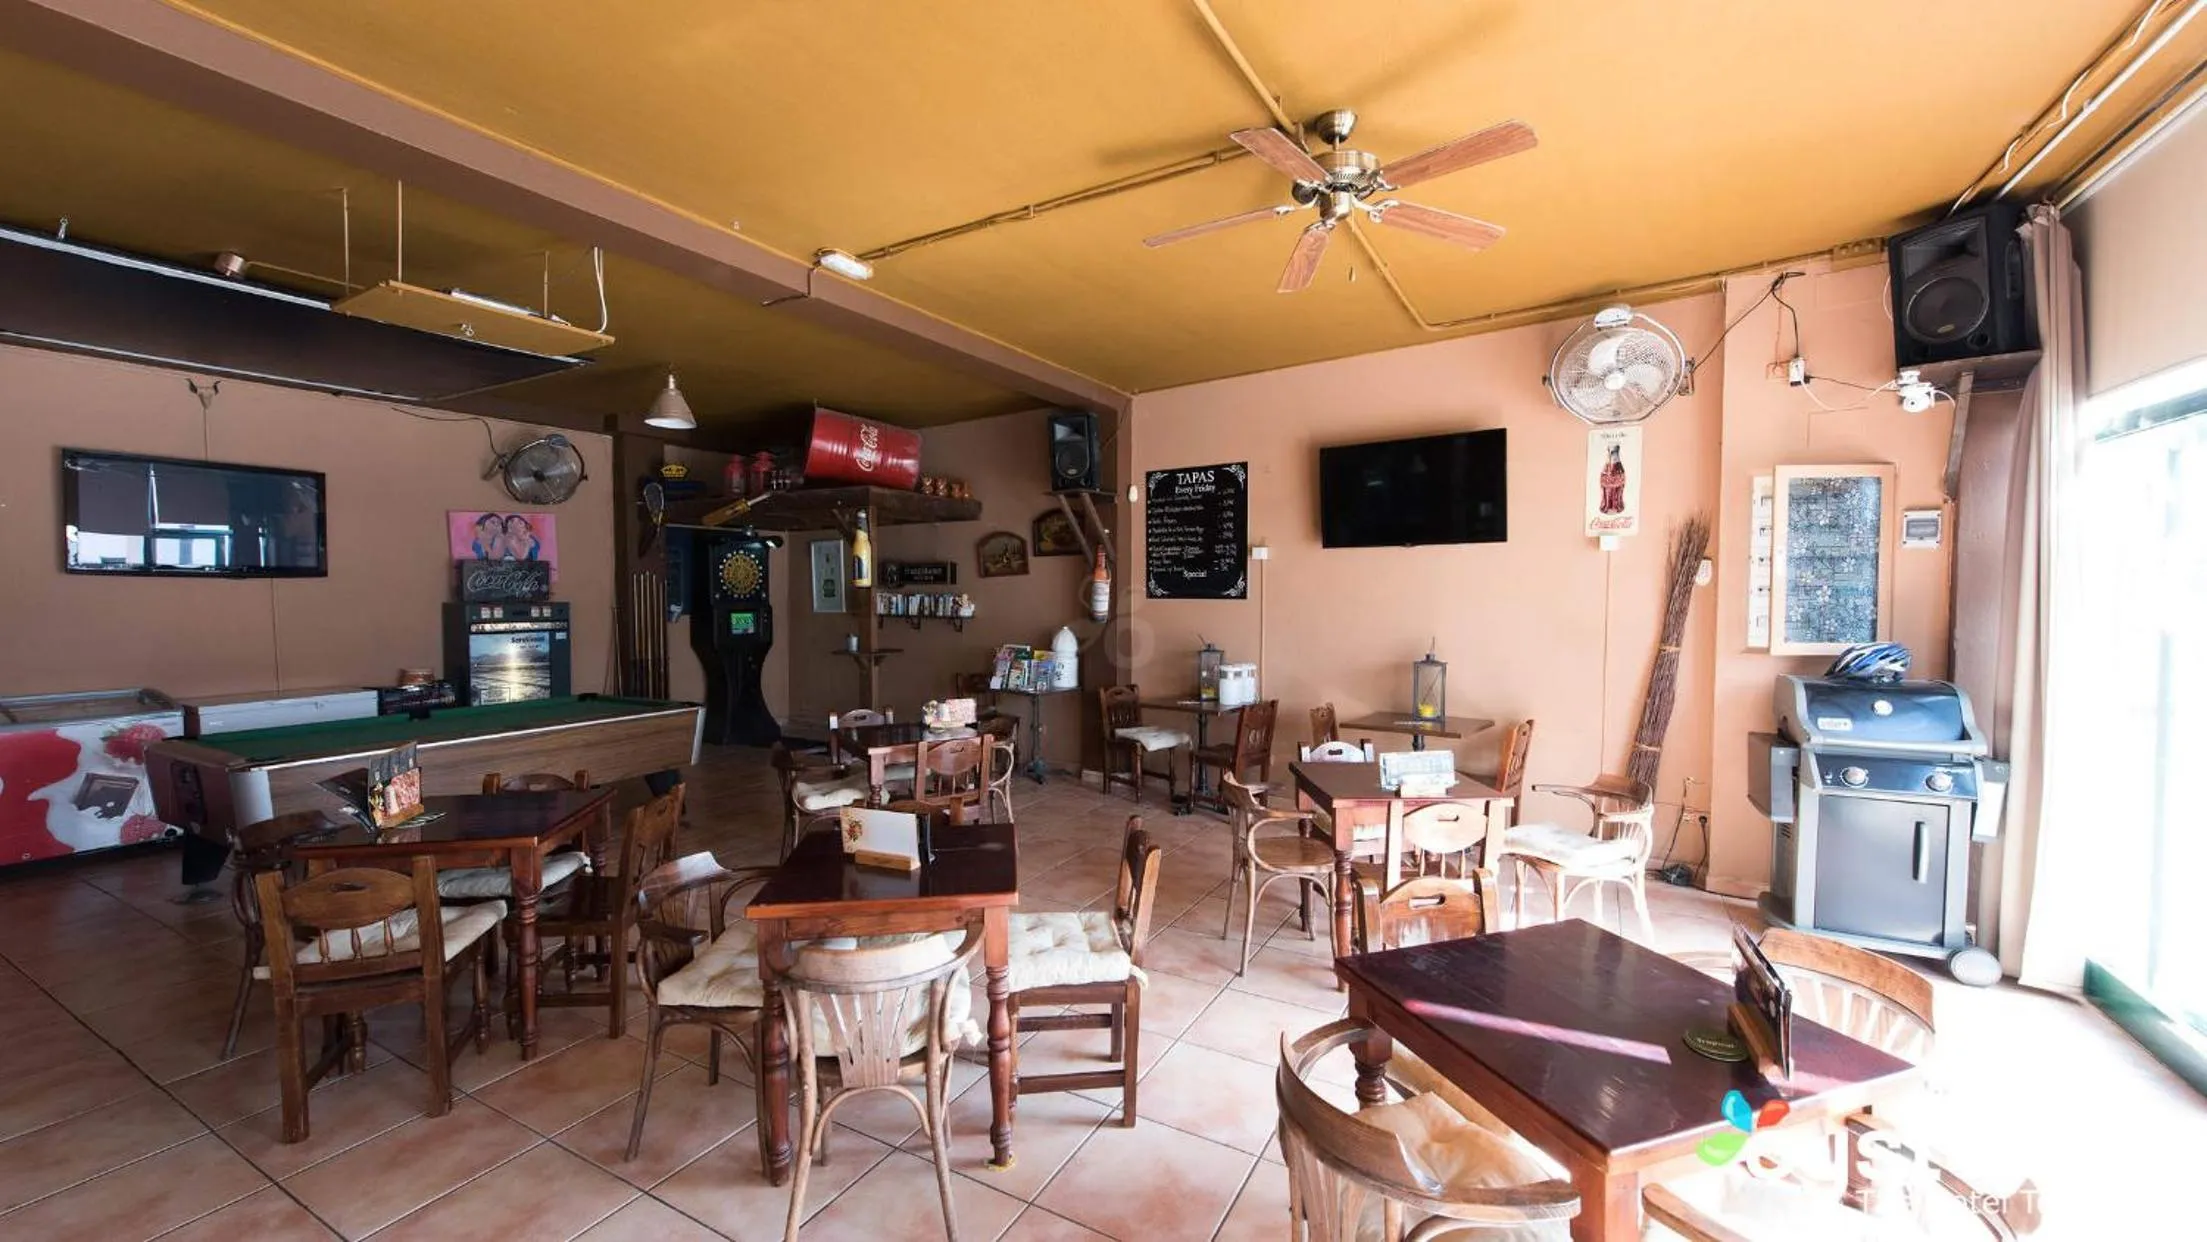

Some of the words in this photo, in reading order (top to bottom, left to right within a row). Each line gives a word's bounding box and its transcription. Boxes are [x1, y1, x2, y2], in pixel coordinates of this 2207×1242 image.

[1176, 470, 1215, 484] TAPAS
[1174, 486, 1193, 496] Every
[1194, 483, 1216, 493] Friday
